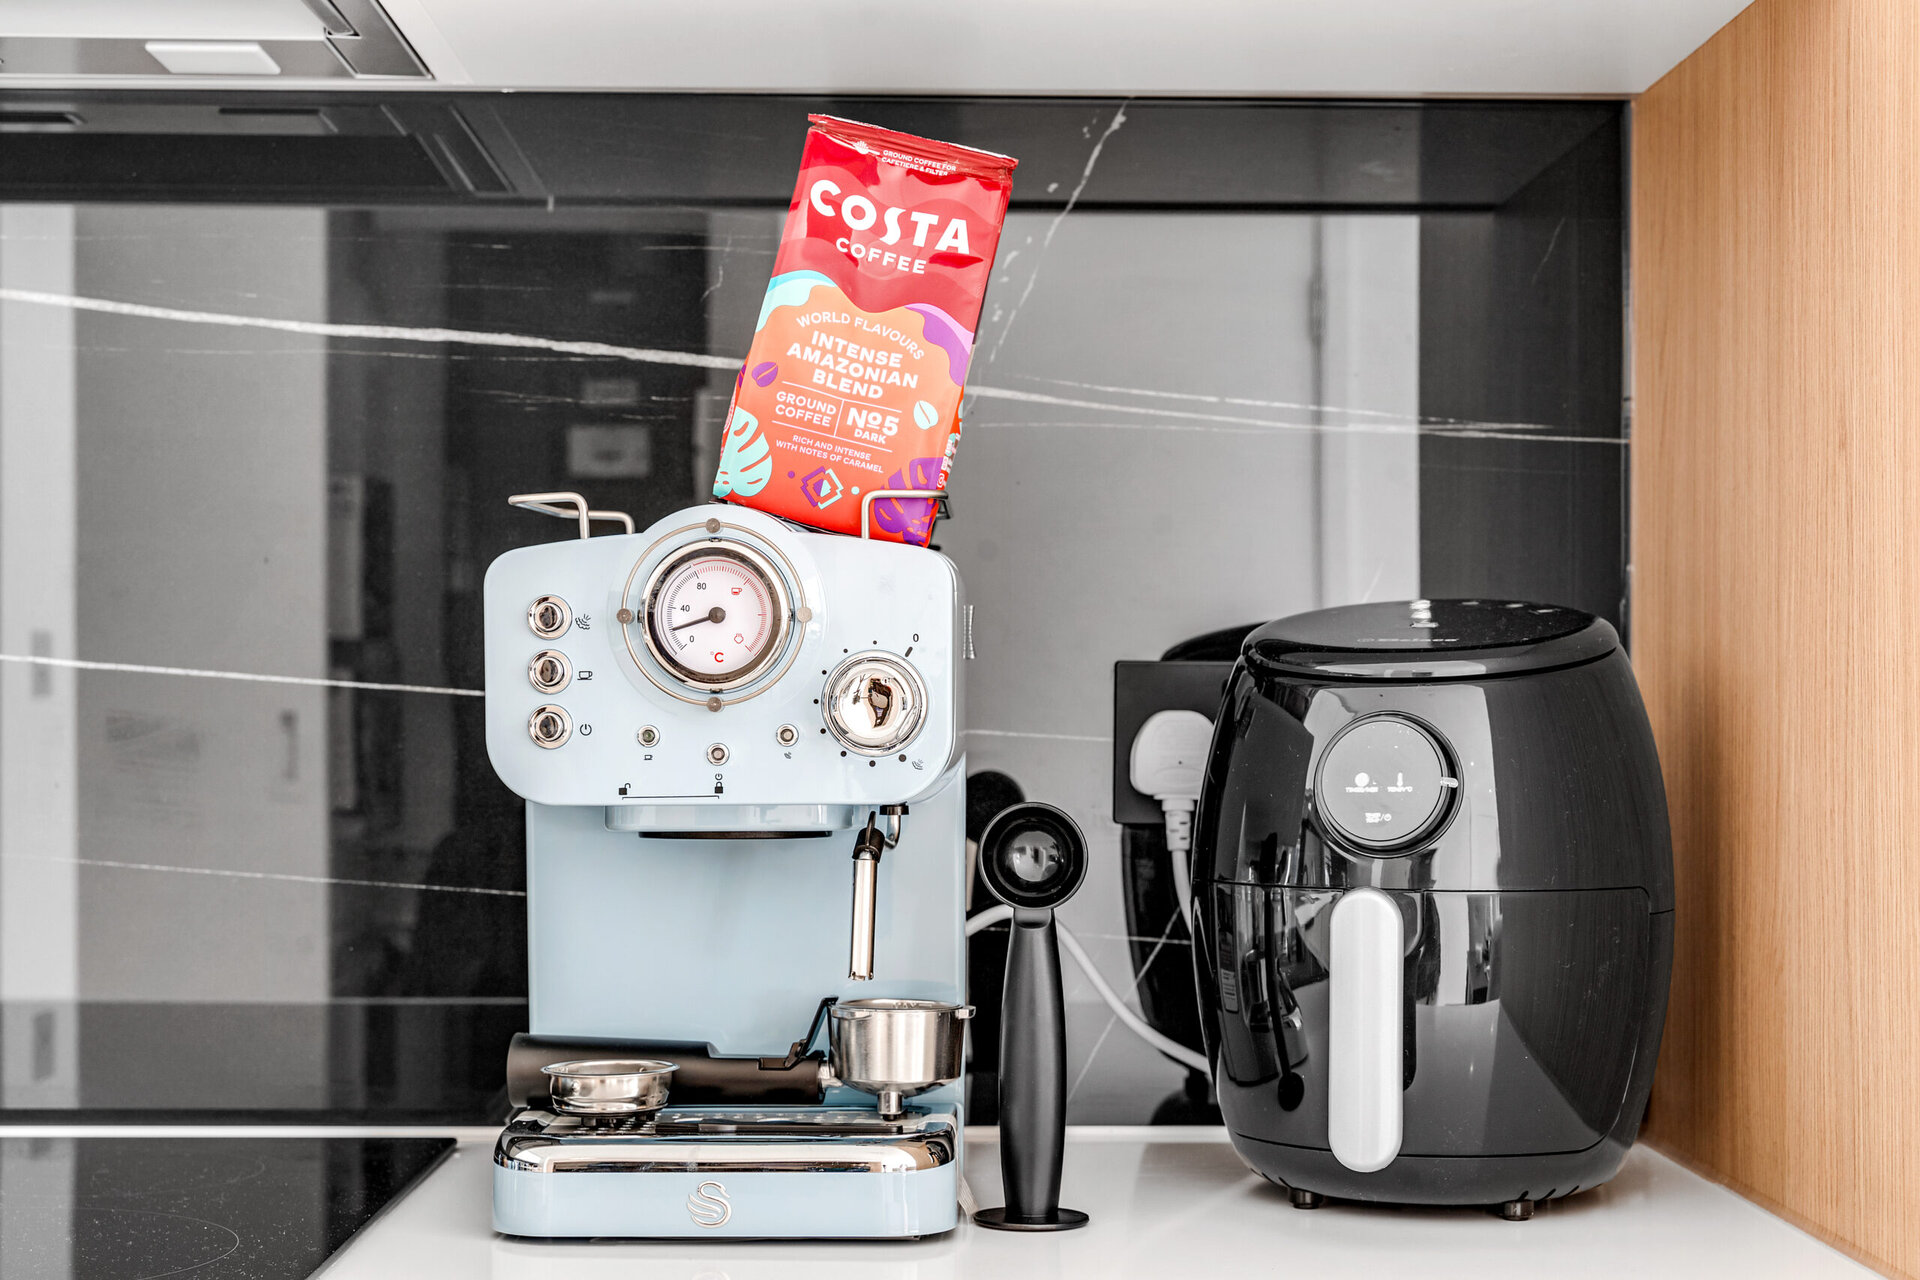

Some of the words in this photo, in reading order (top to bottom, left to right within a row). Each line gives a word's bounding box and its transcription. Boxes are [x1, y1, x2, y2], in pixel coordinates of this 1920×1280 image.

[882, 150, 913, 162] GROUND
[914, 157, 941, 169] COFFEE
[942, 163, 957, 171] FOR
[925, 167, 948, 176] FILTER
[810, 179, 970, 255] COSTA
[836, 237, 927, 275] COFFEE
[796, 311, 850, 328] WORLD
[854, 317, 925, 360] FLAVOURS
[811, 330, 903, 368] INTENSE
[786, 342, 918, 389] AMAZONIAN
[812, 368, 883, 399] BLEND
[775, 404, 832, 427] COFFEE
[776, 391, 837, 415] GROUND
[792, 435, 814, 447] RICH
[814, 440, 833, 451] AND
[834, 446, 871, 461] INTENSE
[854, 428, 886, 444] DARK
[776, 440, 798, 451] WITH
[799, 445, 828, 459] NOTES
[829, 453, 842, 462] OF
[843, 457, 884, 474] CARAMEL
[696, 582, 707, 590] 80
[689, 635, 695, 643] 0
